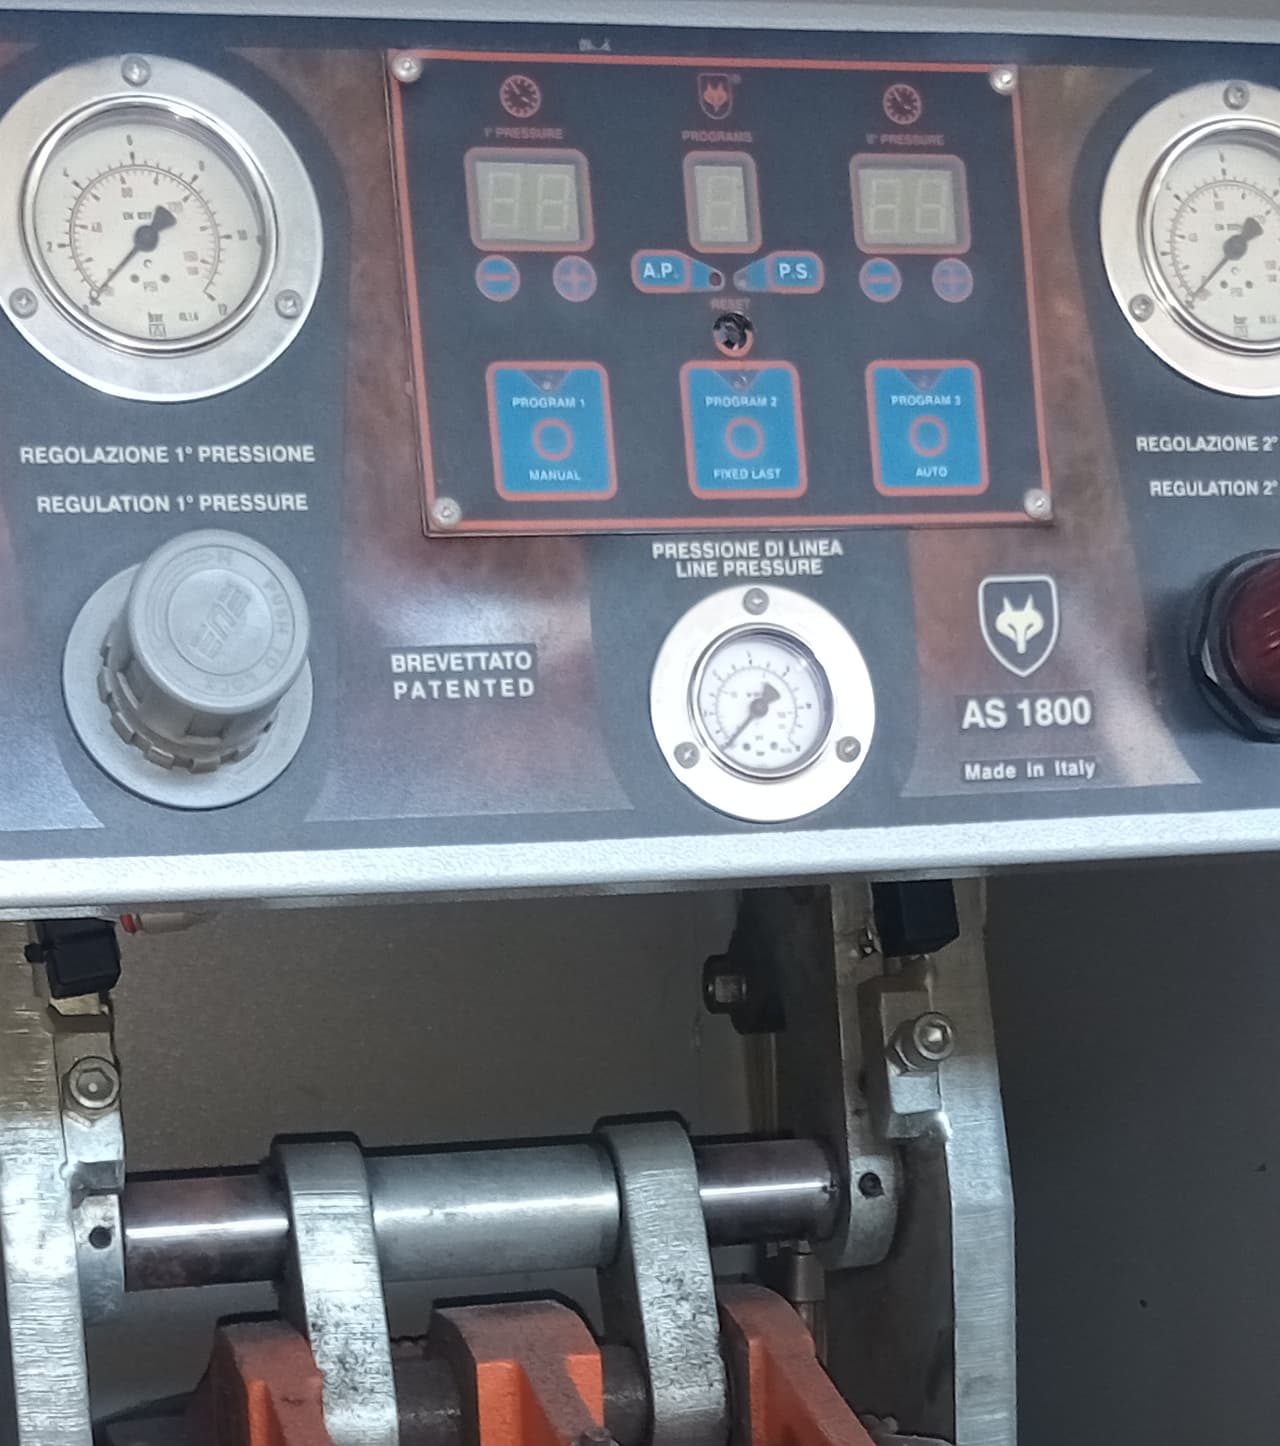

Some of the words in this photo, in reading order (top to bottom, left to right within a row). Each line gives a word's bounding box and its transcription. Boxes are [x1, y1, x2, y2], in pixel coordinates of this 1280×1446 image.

[495, 127, 564, 140] PRESSURE
[681, 130, 753, 143] PROGRAMS
[880, 134, 945, 146] PRESSURE
[512, 397, 577, 409] PROGRAM
[705, 396, 766, 409] PROGRAM
[890, 395, 952, 407] PROGRAM
[1136, 436, 1259, 452] REGOLAZIONE
[19, 446, 170, 464] REGOLAZIONE
[198, 445, 316, 463] PRESSIONE
[529, 469, 581, 481] MANUAL
[713, 468, 748, 480] FIXED
[751, 468, 782, 480] LAST
[915, 467, 949, 478] AUTO
[1149, 480, 1259, 497] REGULATION
[37, 495, 170, 513] REGULATION
[199, 494, 309, 512] PRESSURE
[652, 542, 761, 560] PRESSIONE
[765, 541, 785, 557] DI
[788, 539, 844, 557] LINEA
[676, 560, 719, 578] LINE
[723, 558, 823, 577] PRESSURE
[391, 651, 532, 674] BREVETTATO
[393, 678, 535, 701] PATENTED
[961, 697, 1008, 730] AS
[1016, 695, 1092, 727] 1800
[964, 763, 1017, 781] Made
[1026, 761, 1045, 778] in
[1054, 759, 1096, 779] Italy
